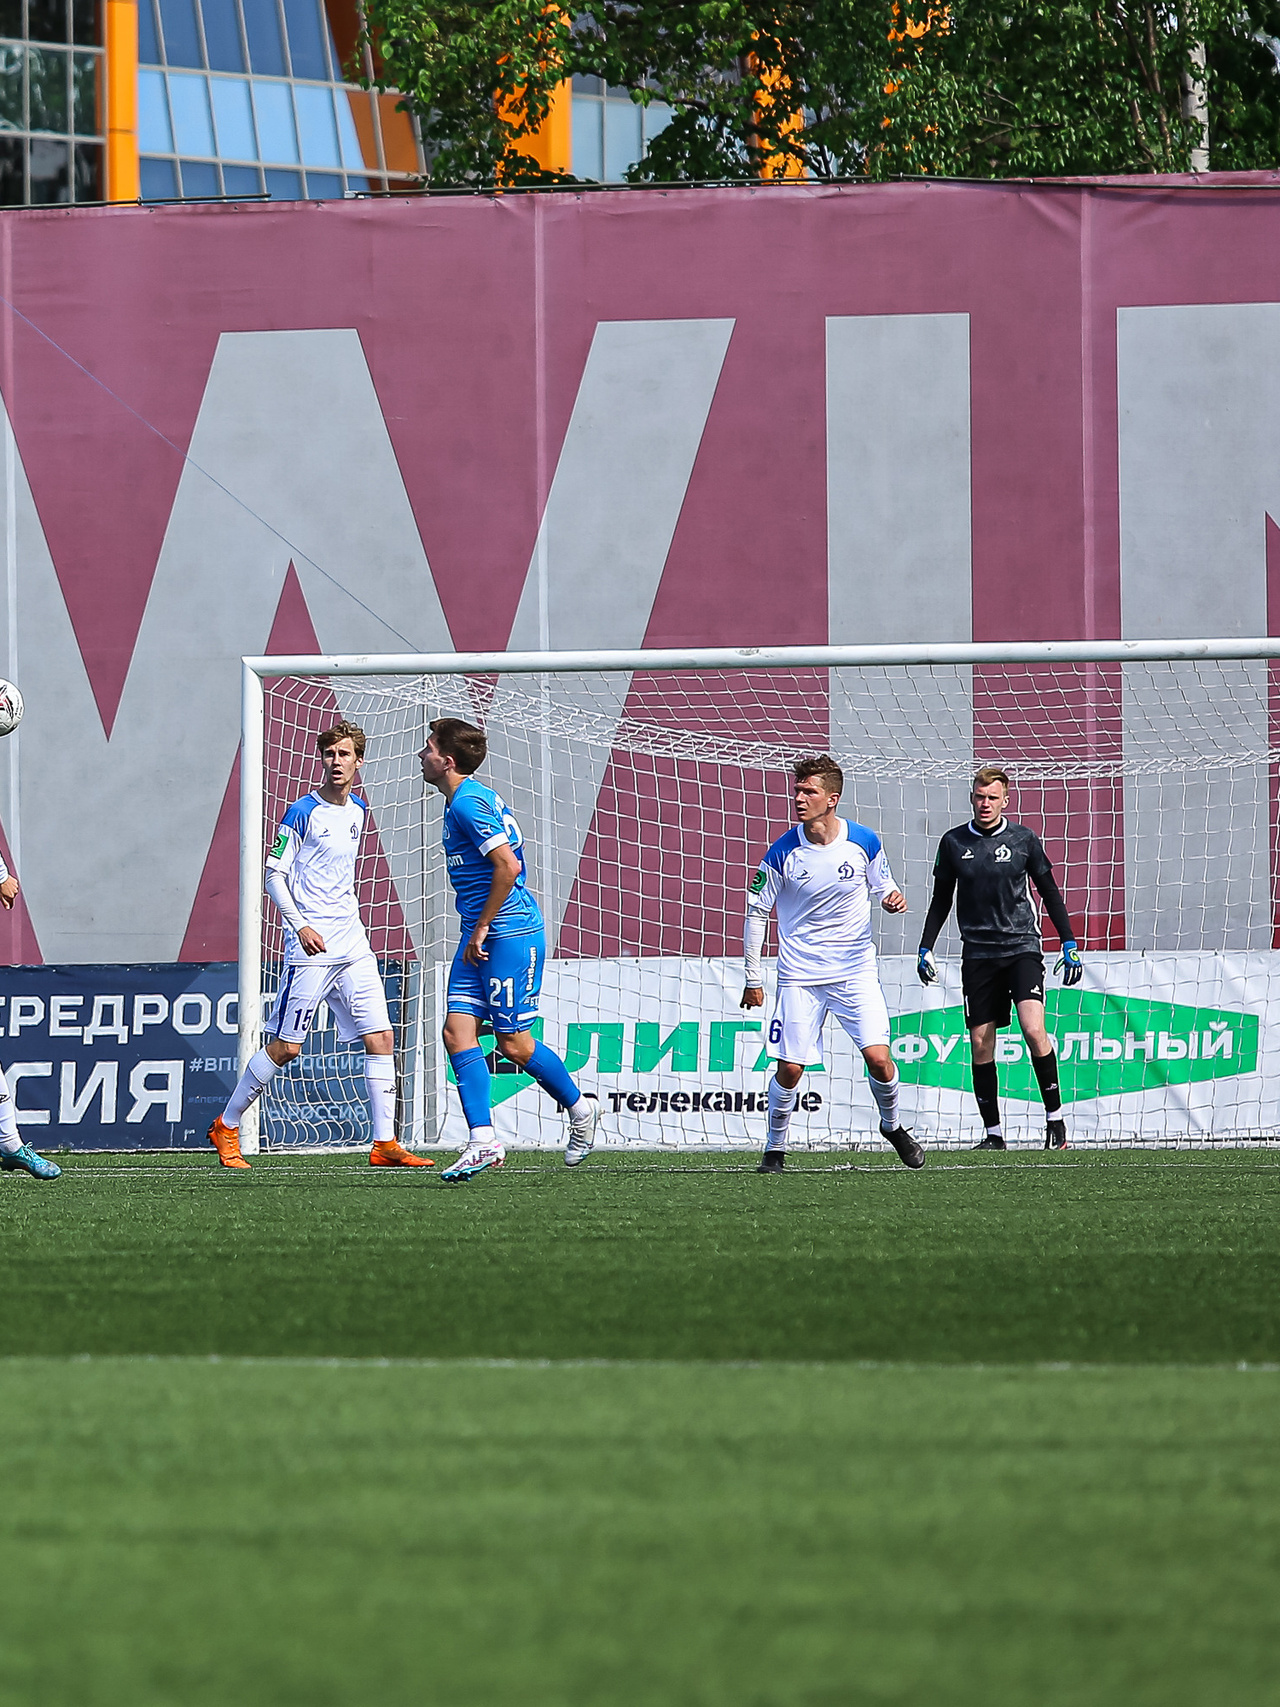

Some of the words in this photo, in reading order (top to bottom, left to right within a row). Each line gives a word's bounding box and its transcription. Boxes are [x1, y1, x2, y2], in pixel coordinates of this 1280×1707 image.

[489, 977, 514, 1008] 21
[292, 1008, 314, 1032] 15
[769, 1019, 782, 1044] 6
